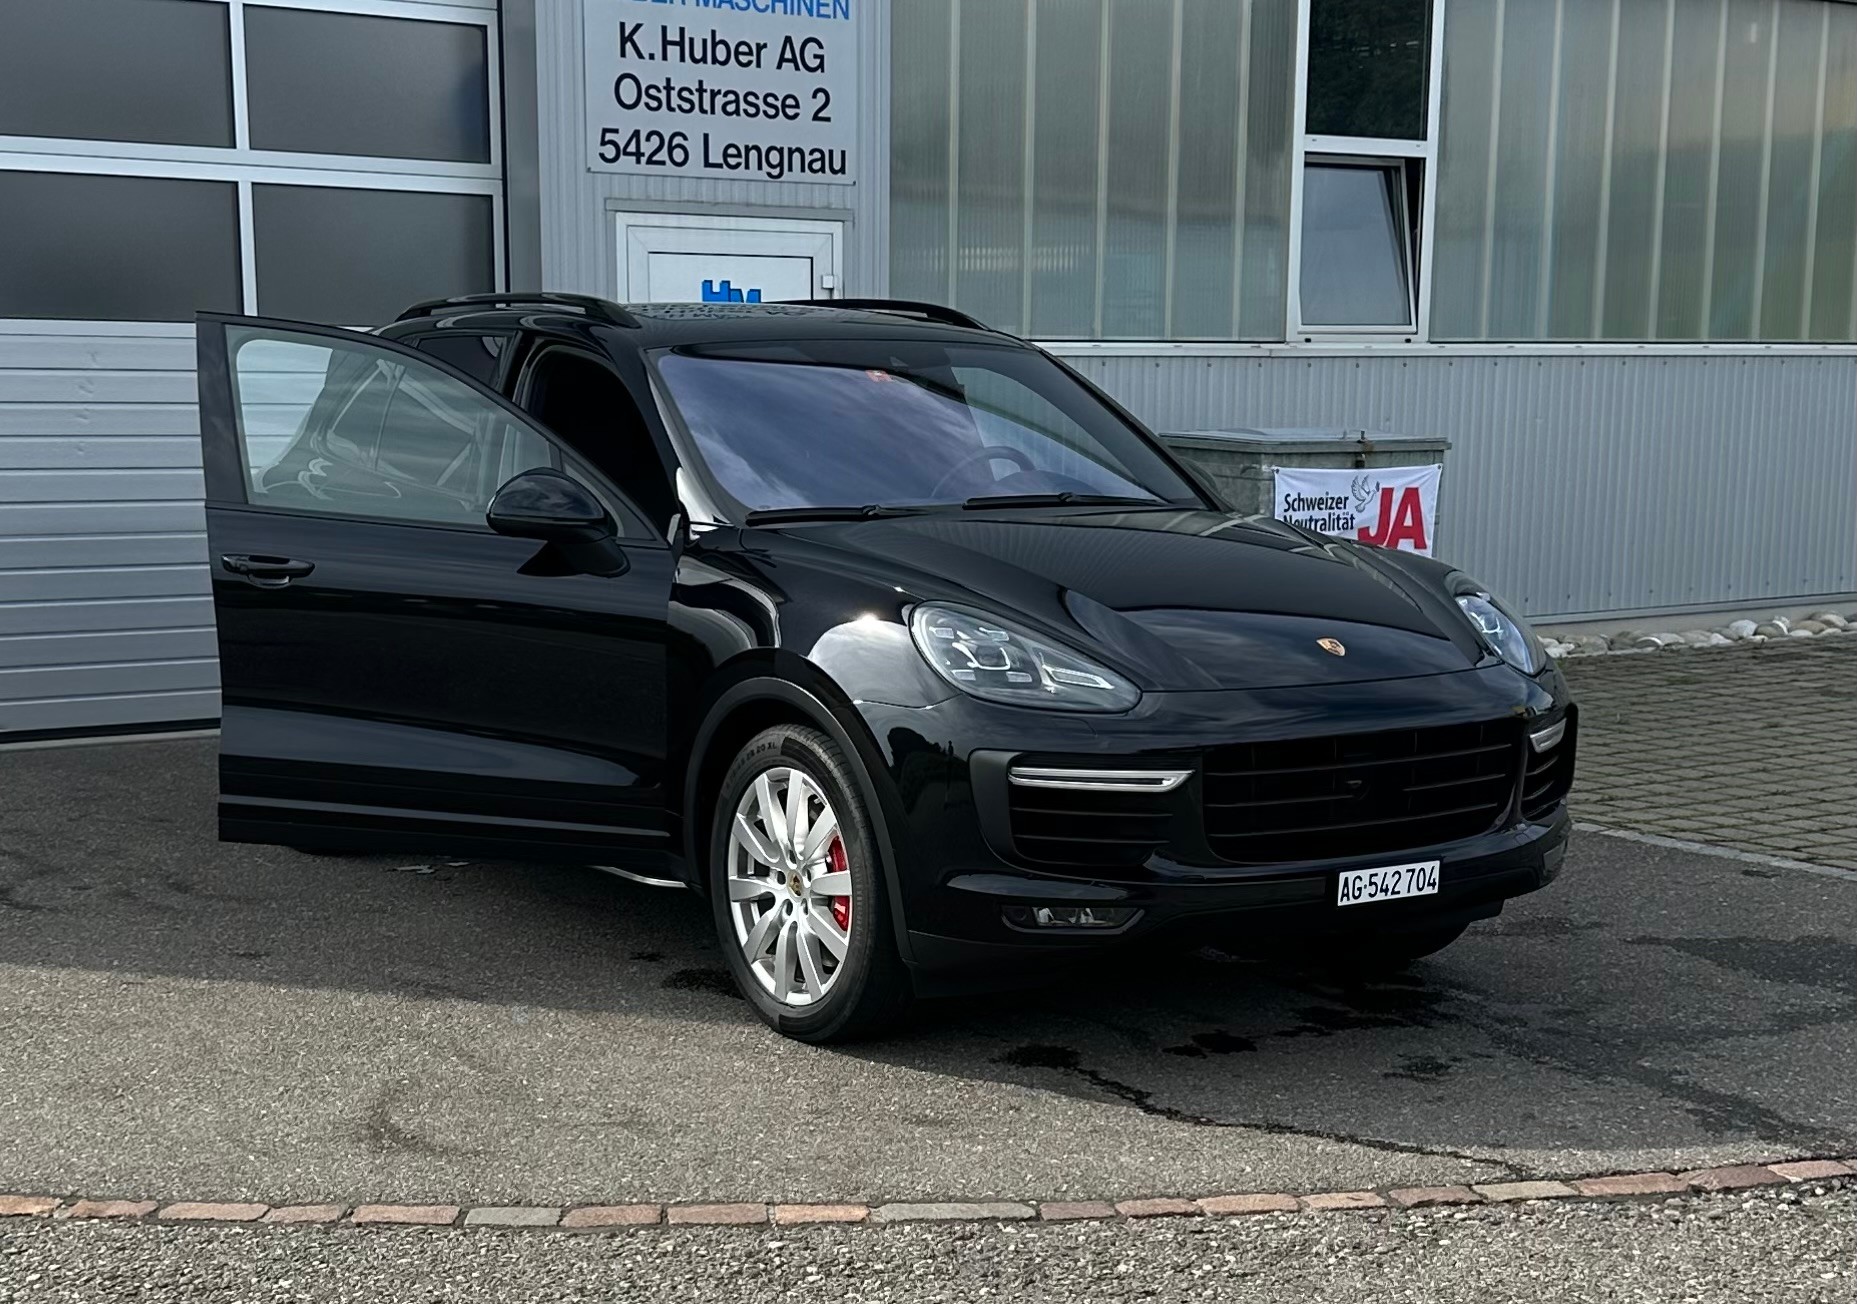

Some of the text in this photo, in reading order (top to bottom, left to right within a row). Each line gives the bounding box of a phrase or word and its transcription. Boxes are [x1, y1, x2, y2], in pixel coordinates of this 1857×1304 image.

[619, 21, 825, 73] K.Huber AG
[614, 72, 831, 122] Oststrasse 2
[598, 127, 846, 179] 5426 Lengnau
[1283, 491, 1349, 512] Schweizer
[1357, 487, 1427, 550] JA
